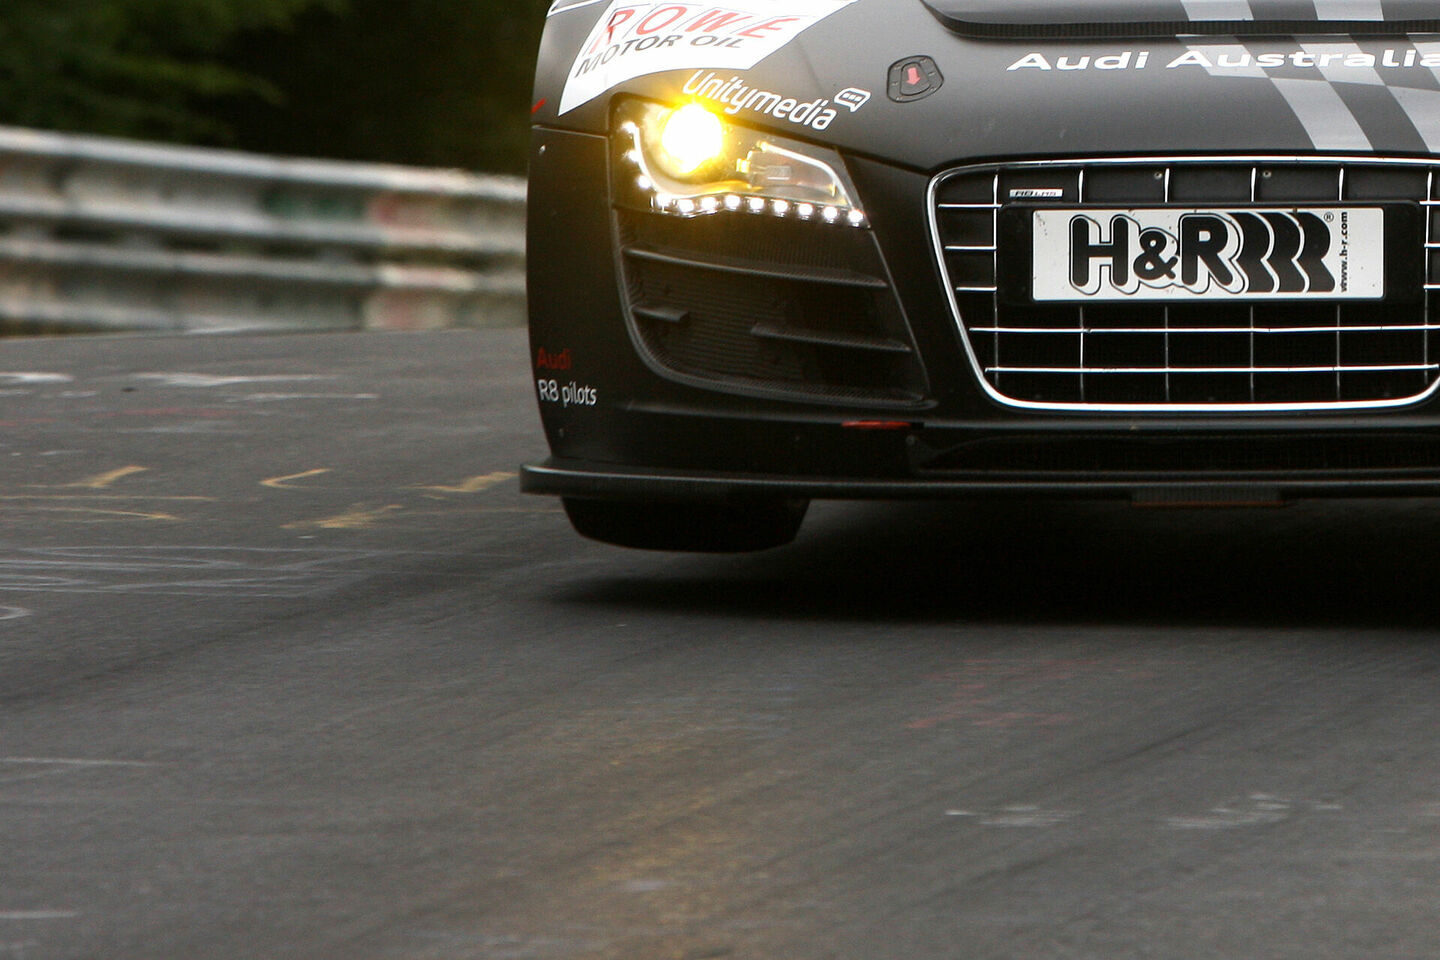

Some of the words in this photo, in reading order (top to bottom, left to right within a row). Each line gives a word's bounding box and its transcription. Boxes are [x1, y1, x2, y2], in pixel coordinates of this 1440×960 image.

[589, 6, 800, 54] ROWE
[575, 34, 684, 78] MOTOR
[690, 35, 745, 49] OIL
[1006, 51, 1149, 71] Audi
[682, 69, 838, 131] Unitymedia
[1338, 211, 1349, 293] www.h-r.com
[536, 346, 573, 370] Audi
[537, 379, 560, 402] R8
[561, 381, 597, 408] pilots
